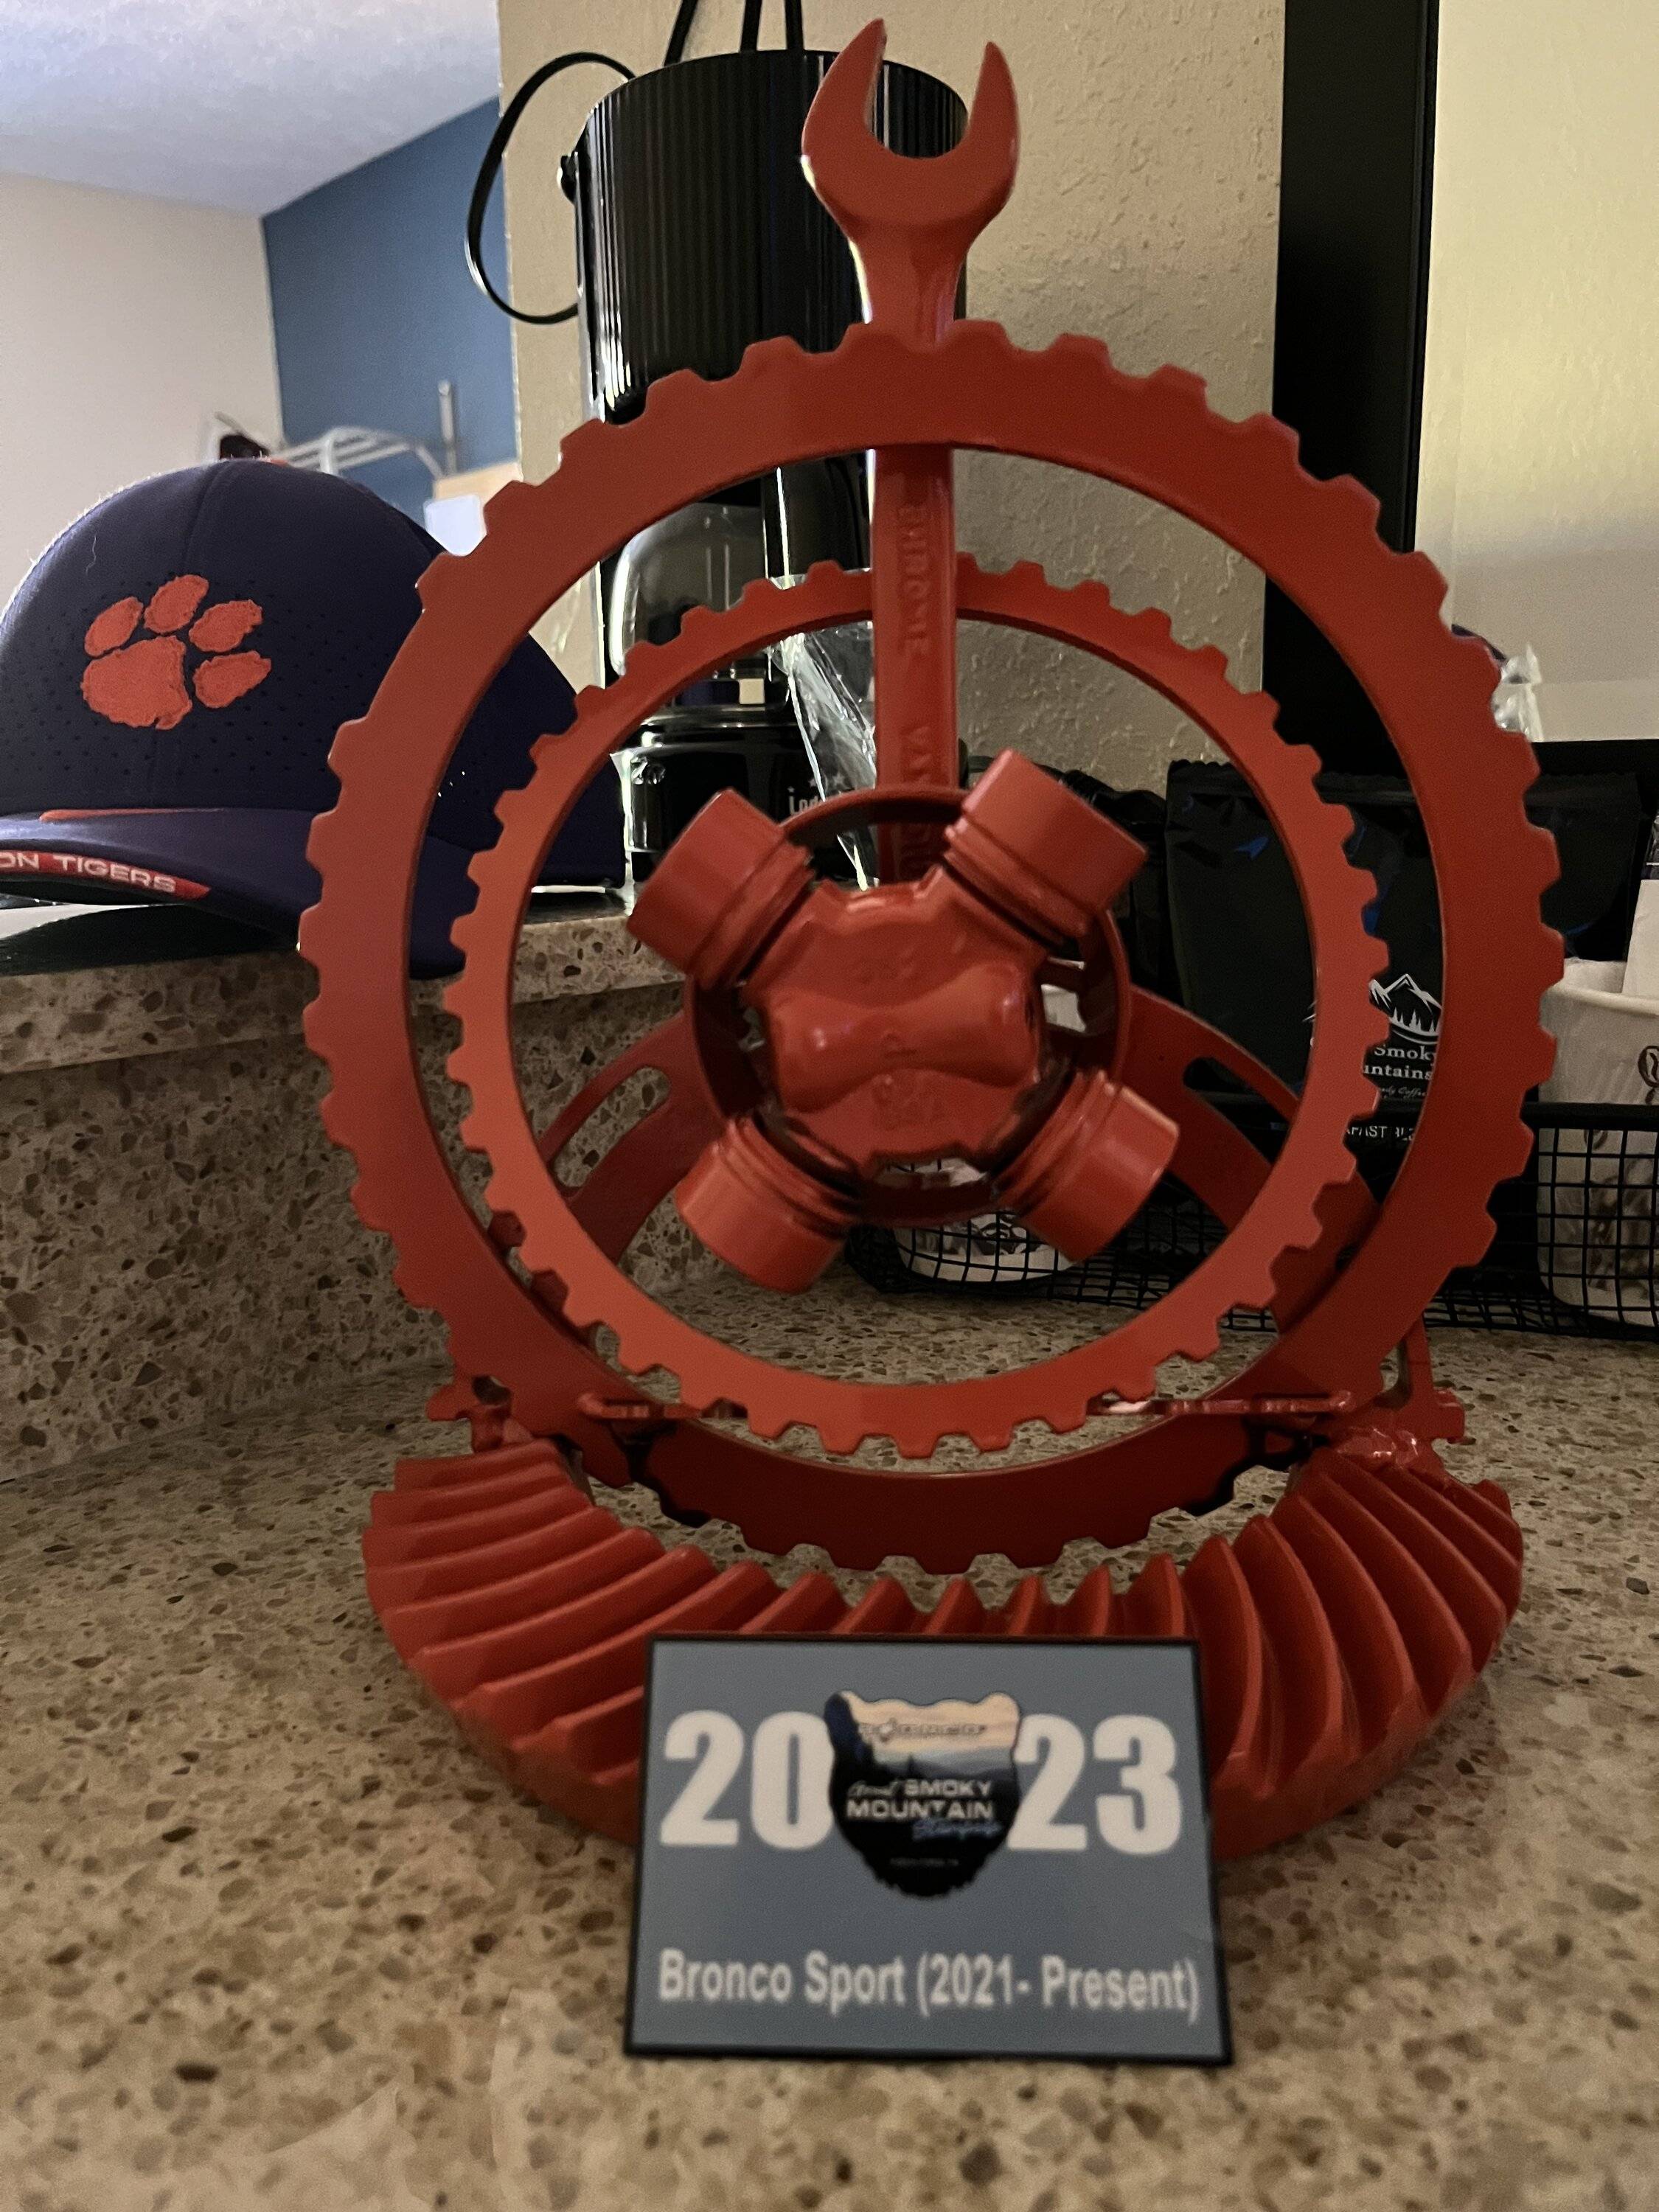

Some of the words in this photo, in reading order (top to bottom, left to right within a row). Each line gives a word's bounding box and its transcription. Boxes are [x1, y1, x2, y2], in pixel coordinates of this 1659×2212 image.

[53, 855, 176, 894] TIGERS
[659, 1710, 834, 1849] 20
[1007, 1714, 1181, 1855] 23
[904, 1778, 992, 1797] SMOKY
[846, 1799, 994, 1820] MOUNTAIN
[660, 1948, 793, 2003] Bronco
[804, 1950, 906, 2017] Sport
[917, 1951, 1031, 2018] (2021-
[1040, 1955, 1200, 2025] Present)
